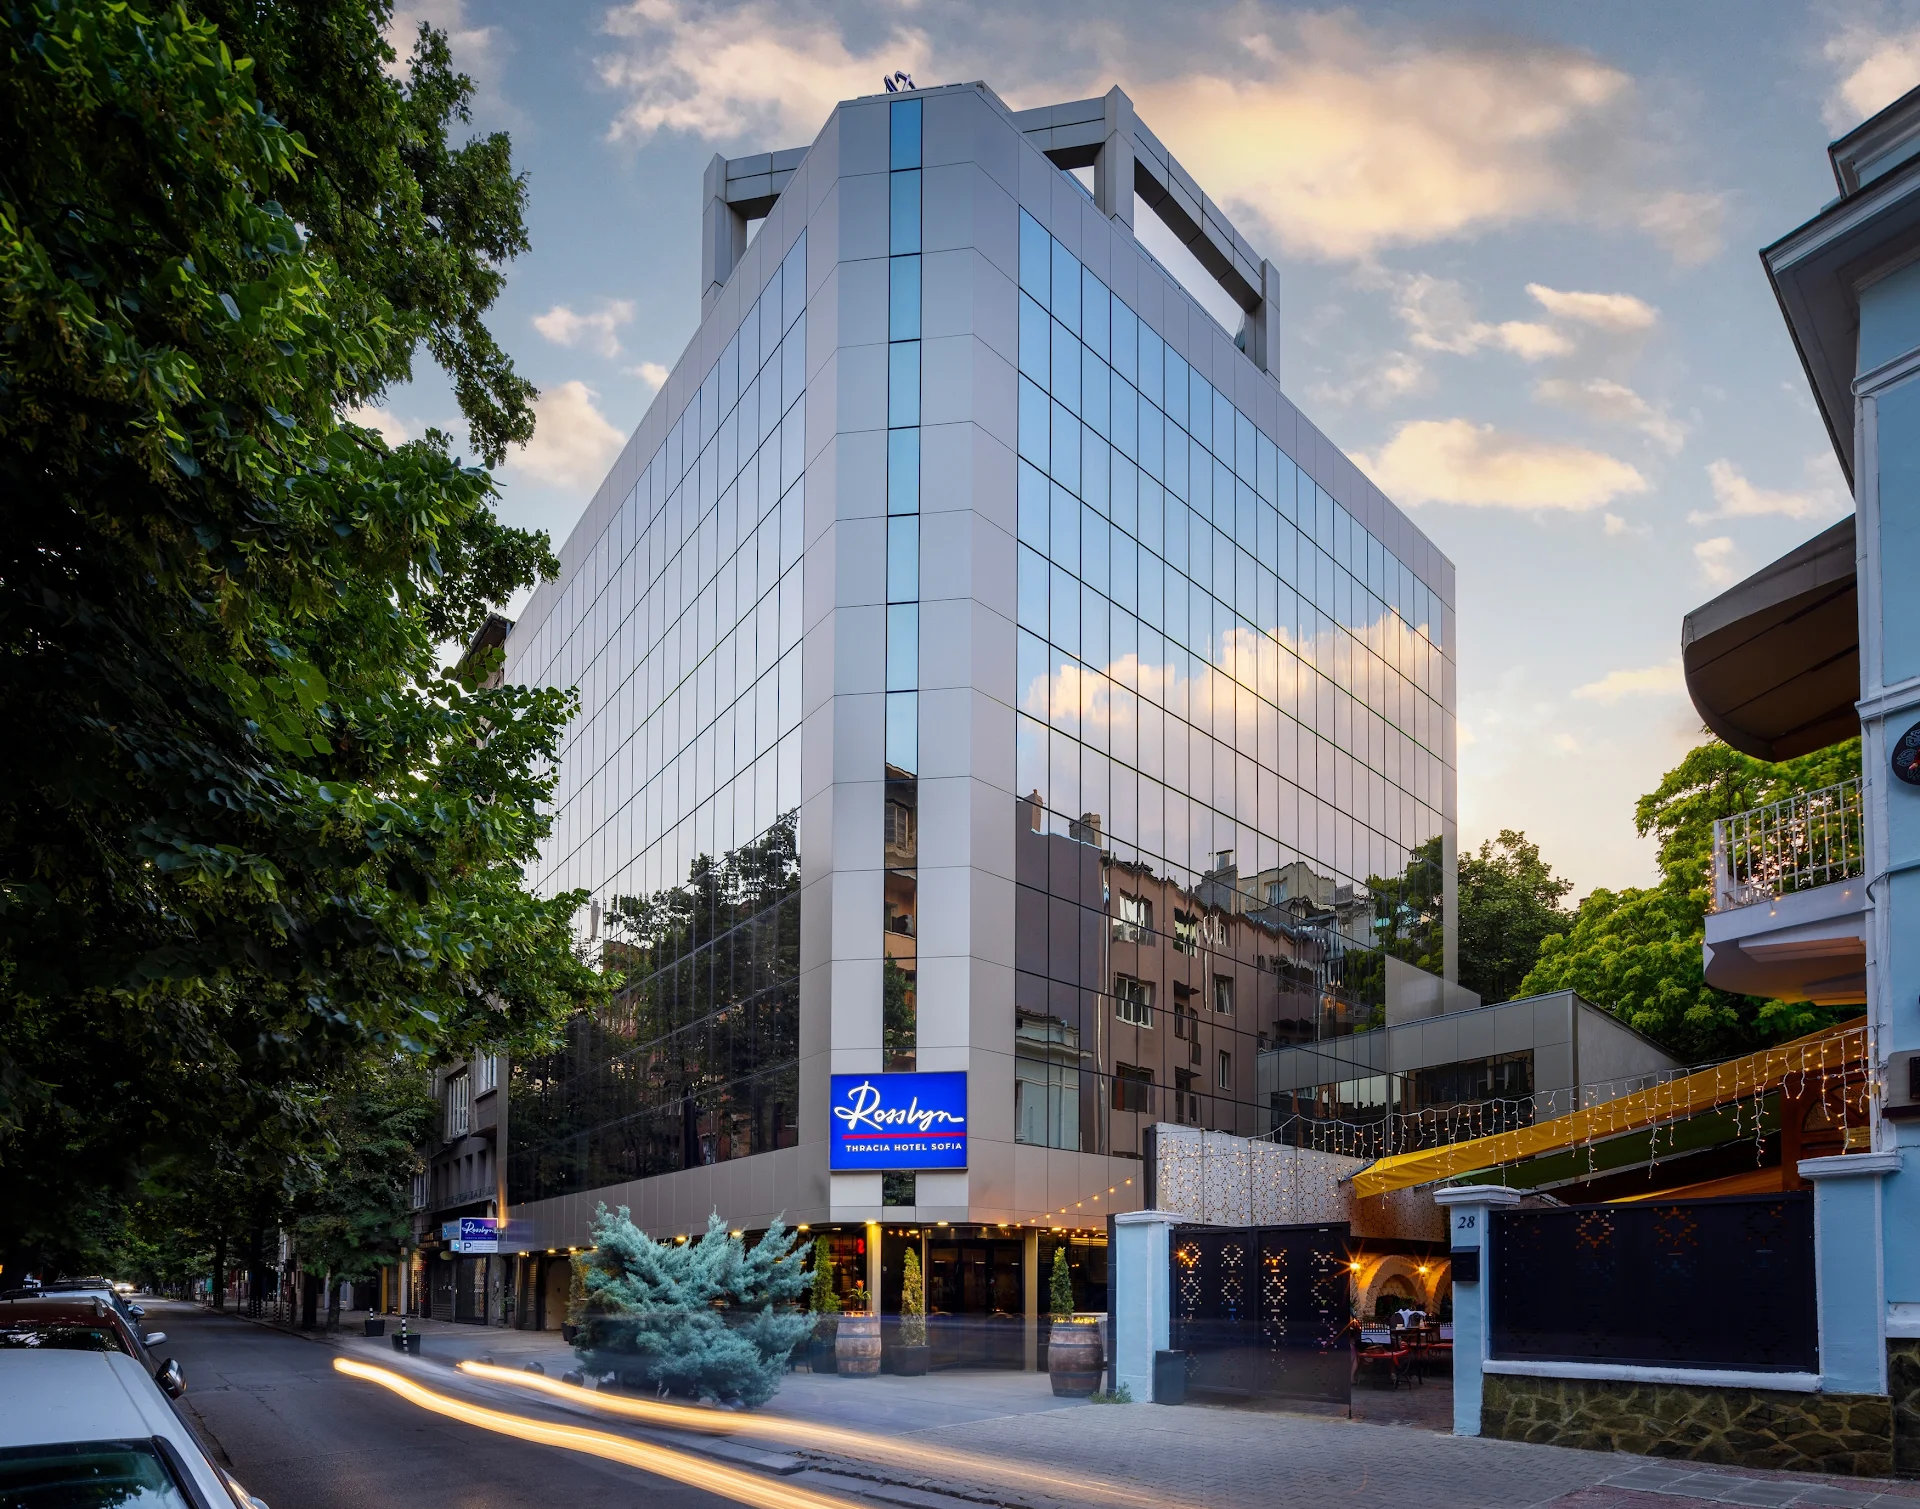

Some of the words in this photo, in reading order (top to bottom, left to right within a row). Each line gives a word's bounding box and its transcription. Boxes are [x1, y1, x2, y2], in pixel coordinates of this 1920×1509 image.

[834, 1081, 964, 1131] Rosslyn
[846, 1144, 890, 1152] THRACIA
[894, 1143, 927, 1151] HOTEL
[931, 1142, 962, 1150] SOFIA
[1458, 1216, 1475, 1229] 28
[464, 1242, 472, 1251] P
